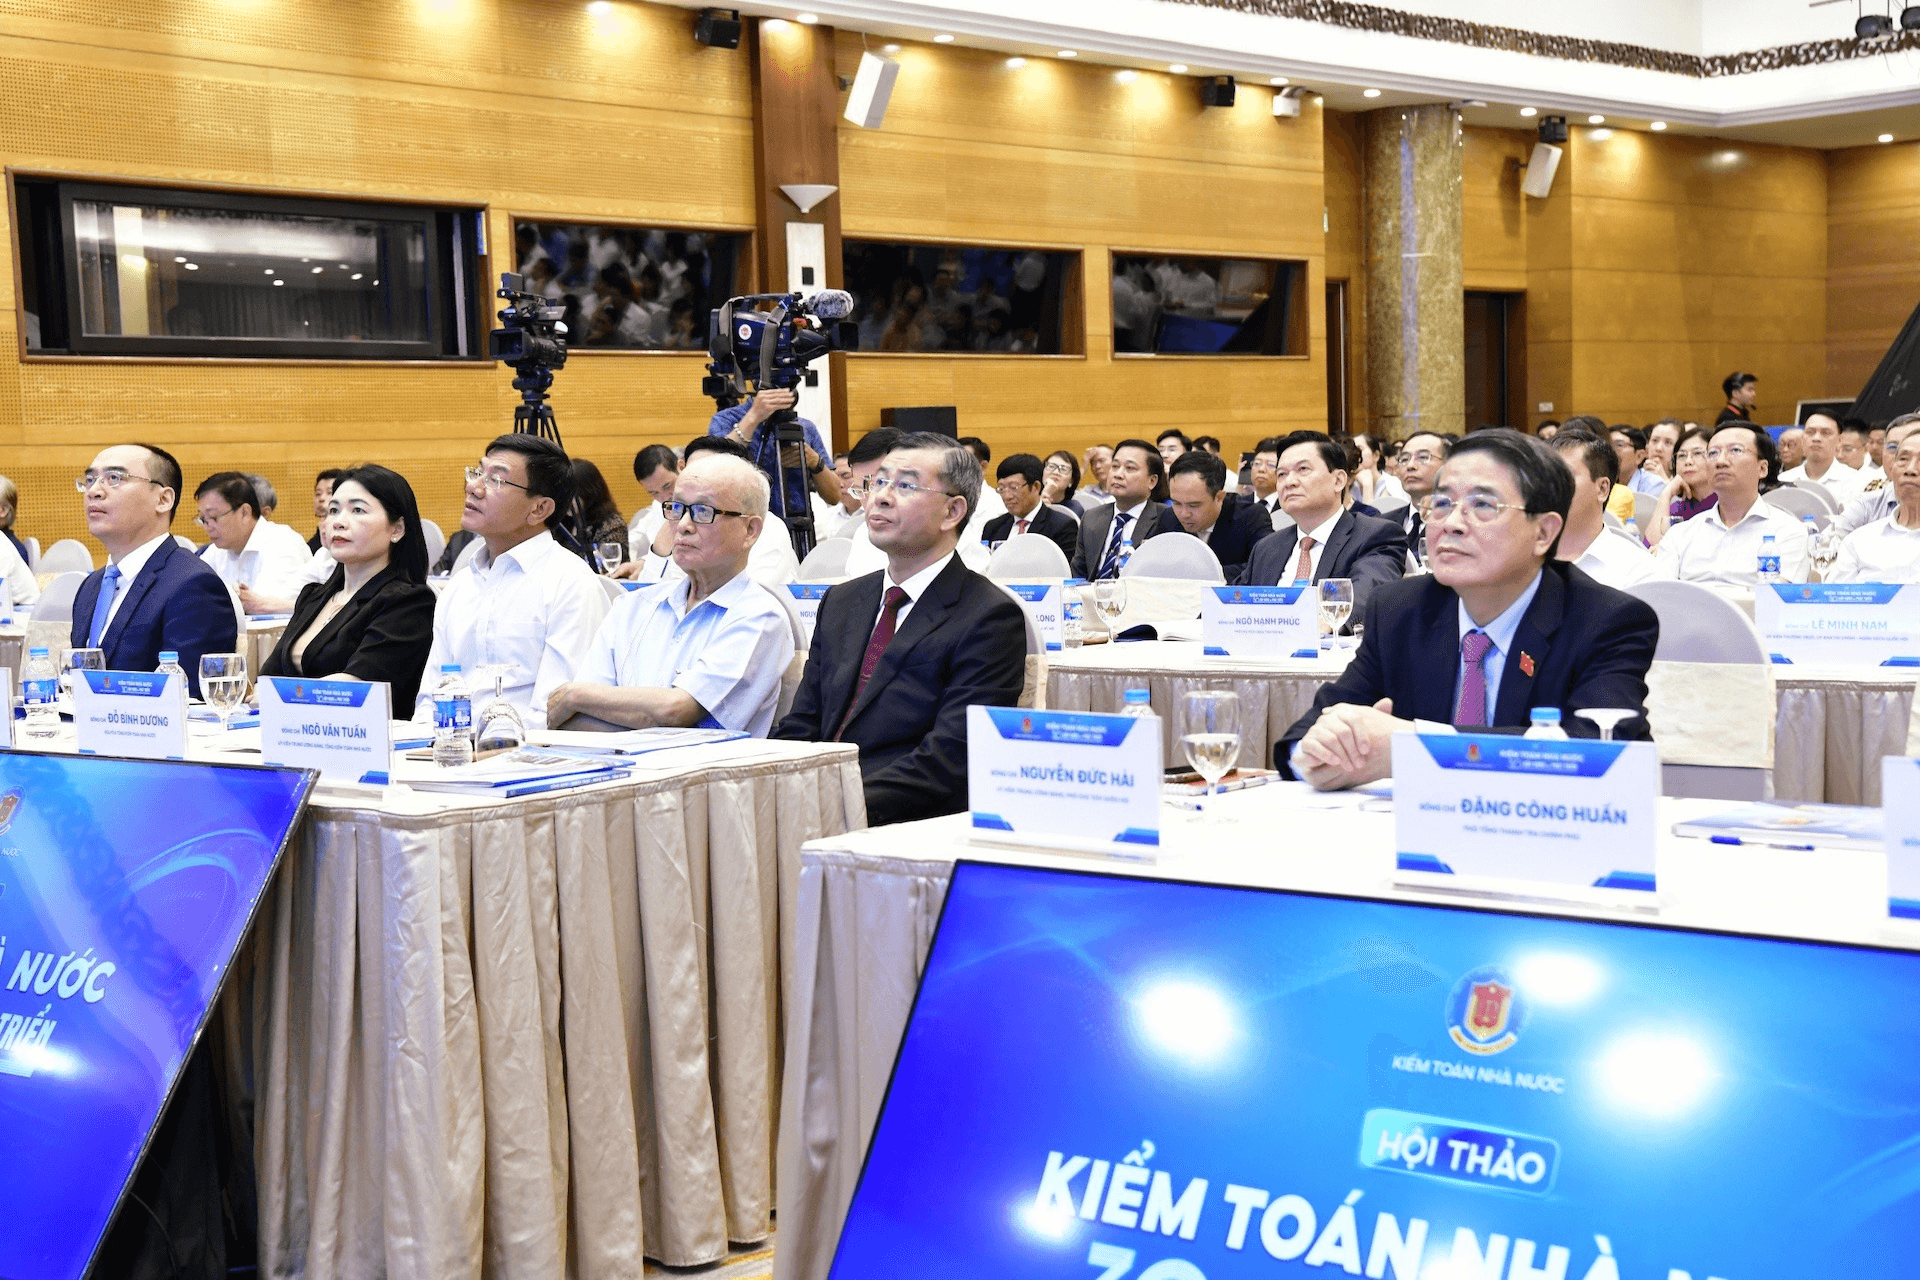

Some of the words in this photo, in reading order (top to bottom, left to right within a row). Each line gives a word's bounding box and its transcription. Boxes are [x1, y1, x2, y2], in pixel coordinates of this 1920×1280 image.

[1236, 616, 1252, 625] NGÔ
[1278, 616, 1300, 625] PHÚC
[1812, 618, 1824, 630] LÊ
[1828, 620, 1858, 630] MINH
[1862, 620, 1888, 630] NAM
[140, 714, 168, 726] DƯƠNG
[302, 722, 320, 735] NGÔ
[322, 723, 340, 737] VĂN
[342, 724, 367, 738] TUẤN
[1020, 763, 1074, 782] NGUYỄN
[1078, 768, 1107, 785] ĐỨC
[1111, 770, 1134, 787] HẢI
[1461, 796, 1511, 818] ĐẶNG
[1516, 800, 1567, 820] CÔNG
[1572, 803, 1627, 825] HUẤN
[6, 948, 116, 1003] NƯỚC
[0, 1003, 57, 1051] TRIỂN
[1392, 1052, 1431, 1074] KIỂM
[1433, 1060, 1477, 1080] TOÁN
[1476, 1066, 1512, 1086] NHÀ
[1377, 1127, 1438, 1170] HỘI
[1448, 1138, 1546, 1184] THẢO
[1034, 1140, 1208, 1241] KIỂM
[1223, 1189, 1429, 1280] TOÁN
